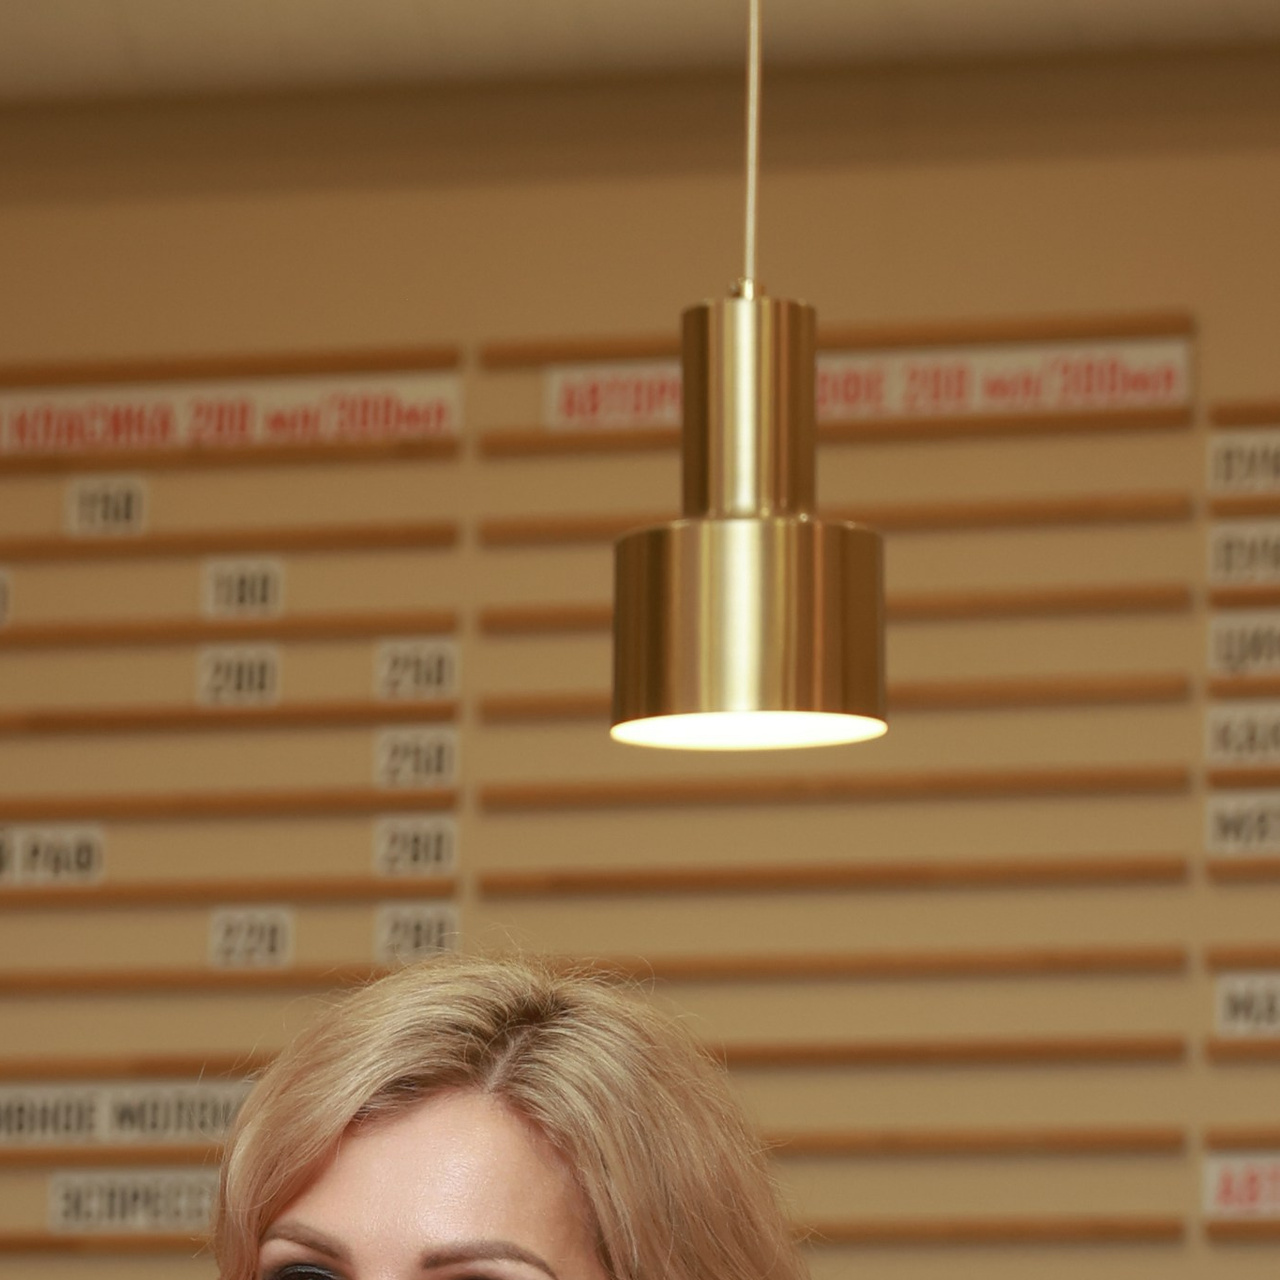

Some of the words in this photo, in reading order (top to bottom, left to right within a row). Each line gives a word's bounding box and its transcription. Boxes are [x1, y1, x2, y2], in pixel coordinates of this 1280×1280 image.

[188, 399, 253, 441] 200
[78, 486, 140, 530] 150
[382, 650, 452, 694] 250
[382, 738, 452, 783] 250
[22, 836, 101, 879] РАФ
